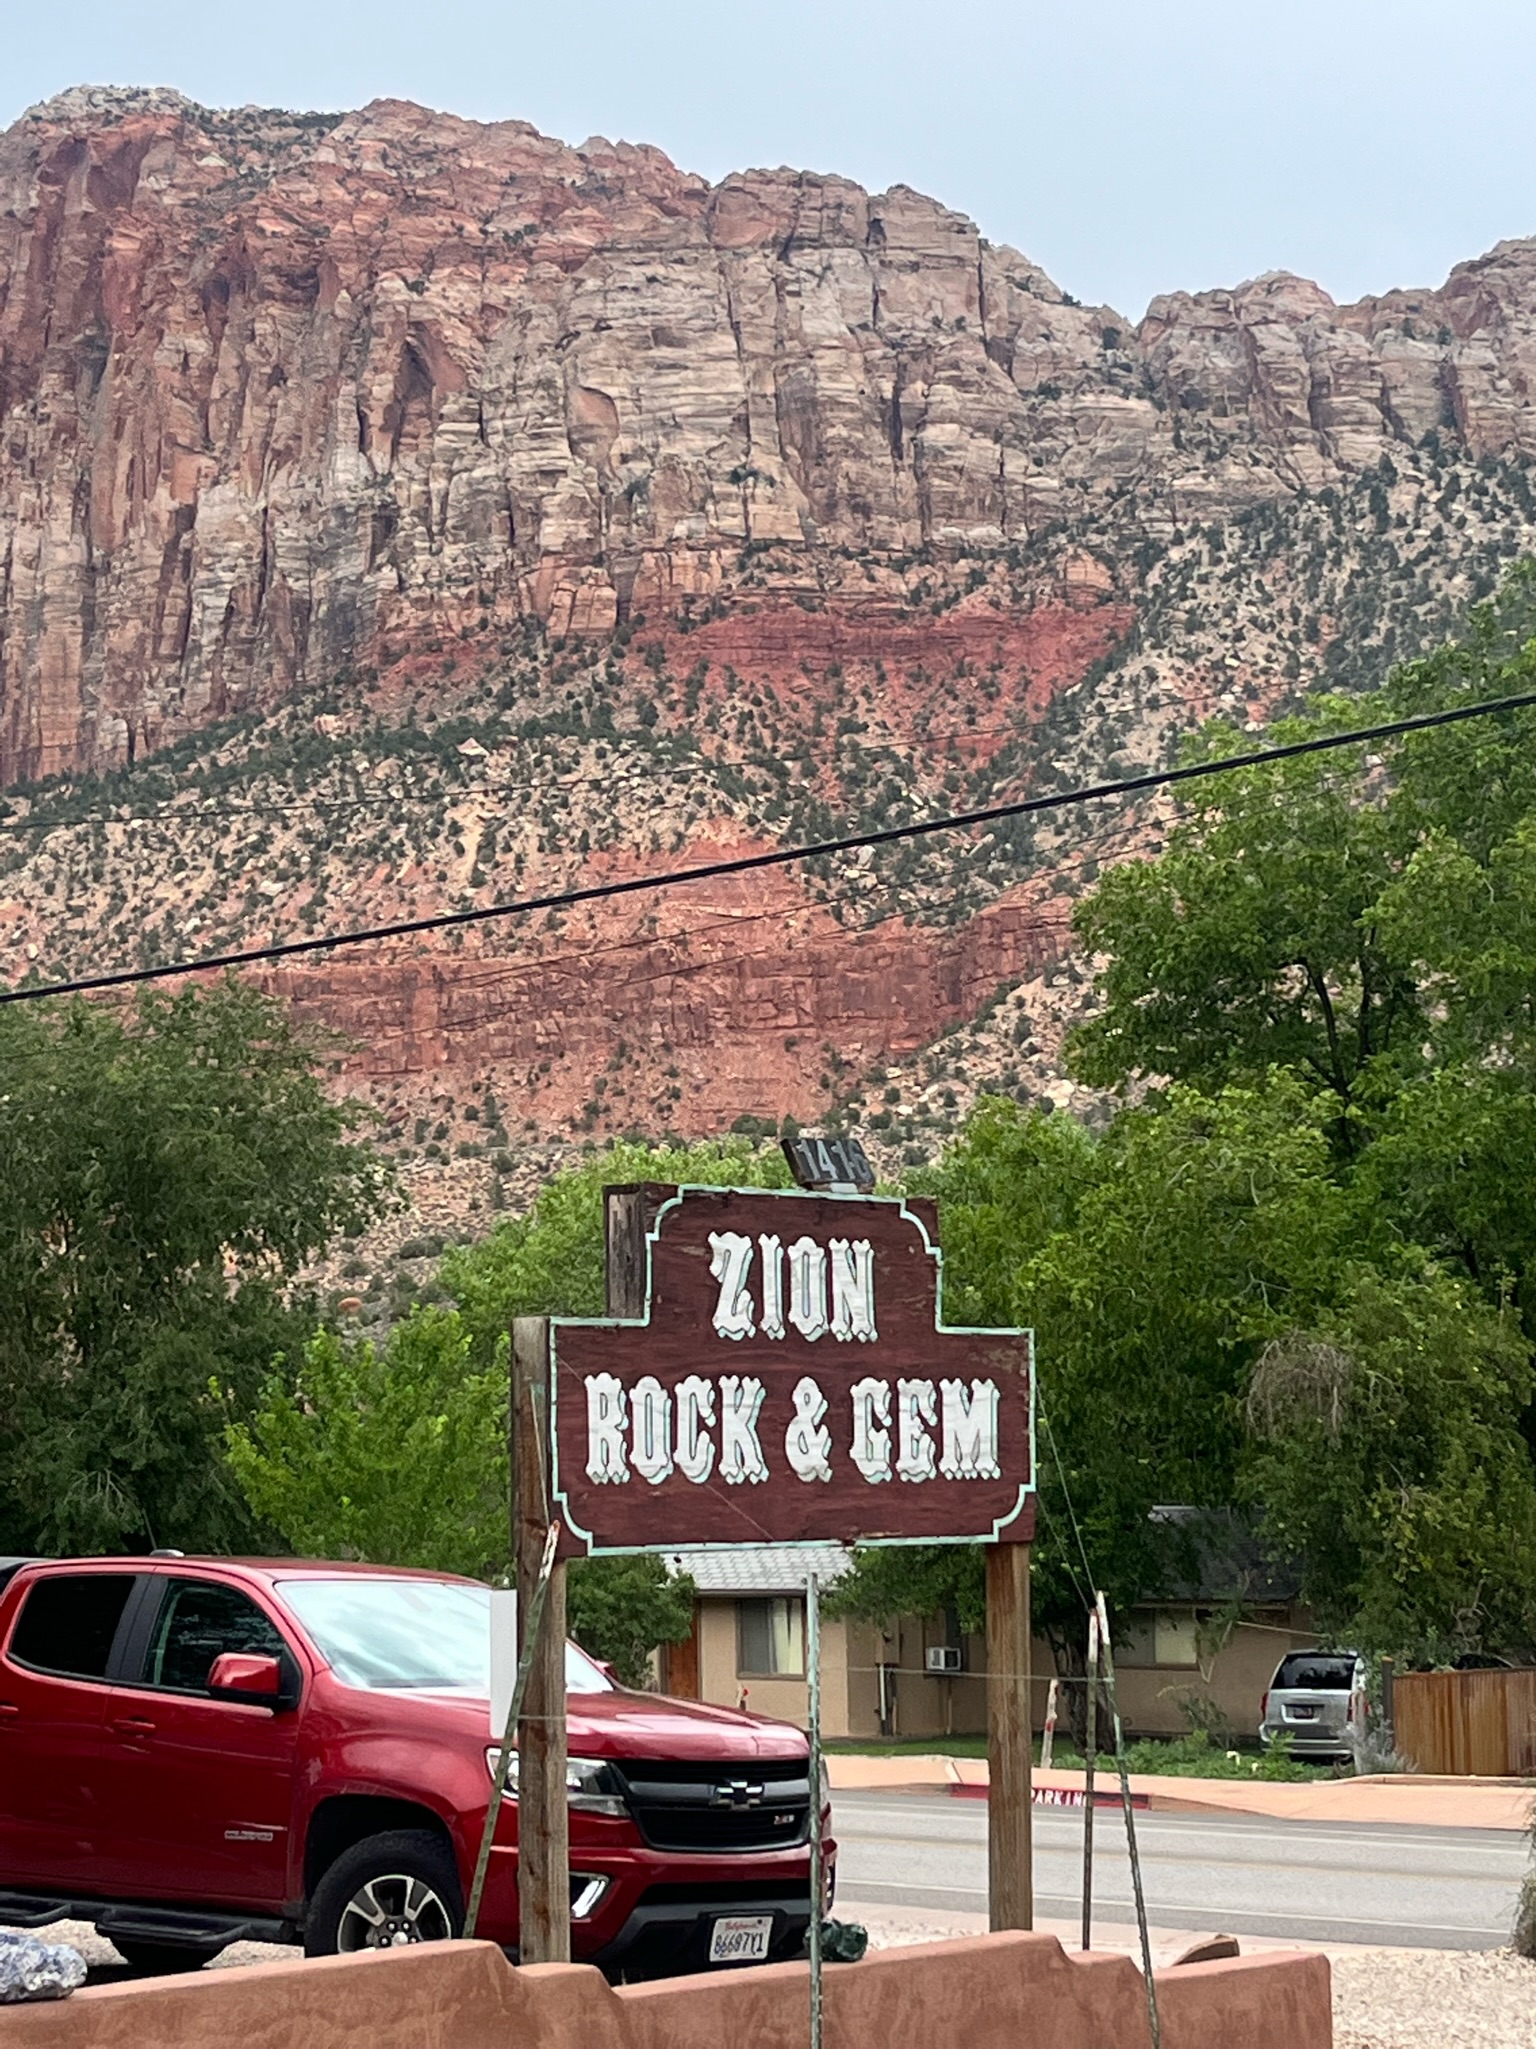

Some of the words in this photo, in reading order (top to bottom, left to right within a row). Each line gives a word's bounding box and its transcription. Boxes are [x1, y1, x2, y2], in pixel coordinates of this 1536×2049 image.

[795, 1138, 870, 1179] 1416
[708, 1231, 878, 1342] ZION
[585, 1372, 769, 1484] ROCK
[785, 1376, 833, 1483] &
[850, 1377, 1001, 1484] GEM
